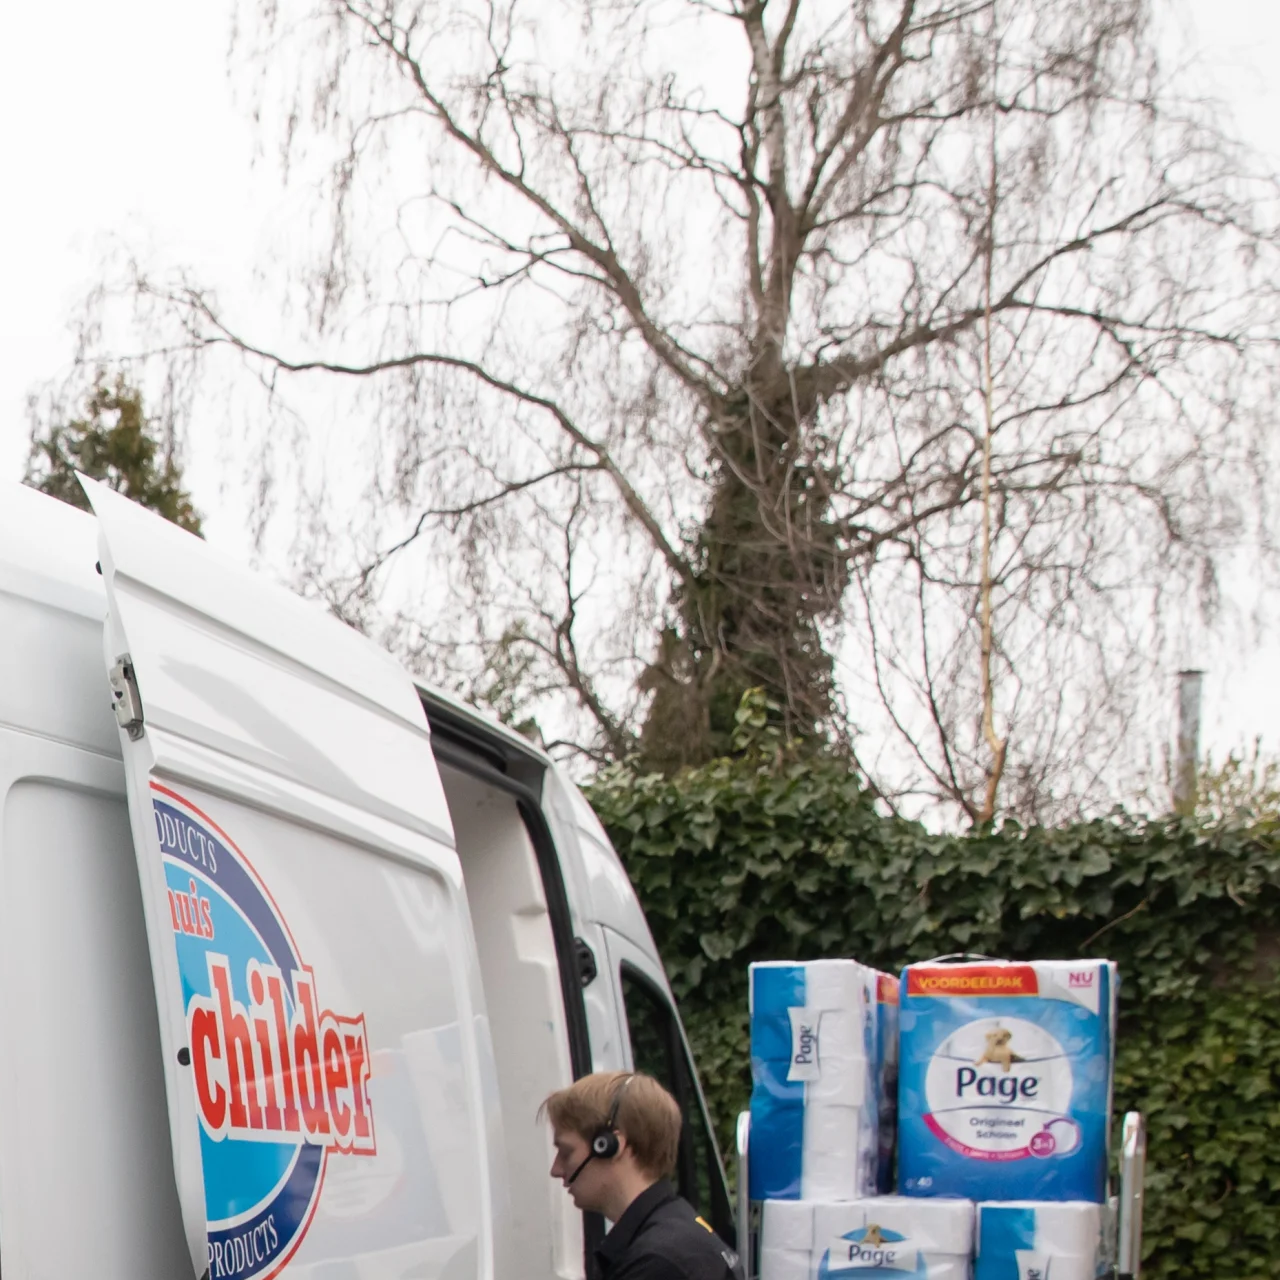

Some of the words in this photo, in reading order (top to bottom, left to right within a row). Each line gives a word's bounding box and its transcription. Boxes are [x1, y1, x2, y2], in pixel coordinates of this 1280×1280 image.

[919, 975, 1023, 990] VOORDEELPAK
[1069, 972, 1093, 984] NU
[191, 965, 371, 1138] childer
[794, 1025, 813, 1065] Page
[956, 1067, 1039, 1103] Page
[848, 1245, 897, 1267] Page
